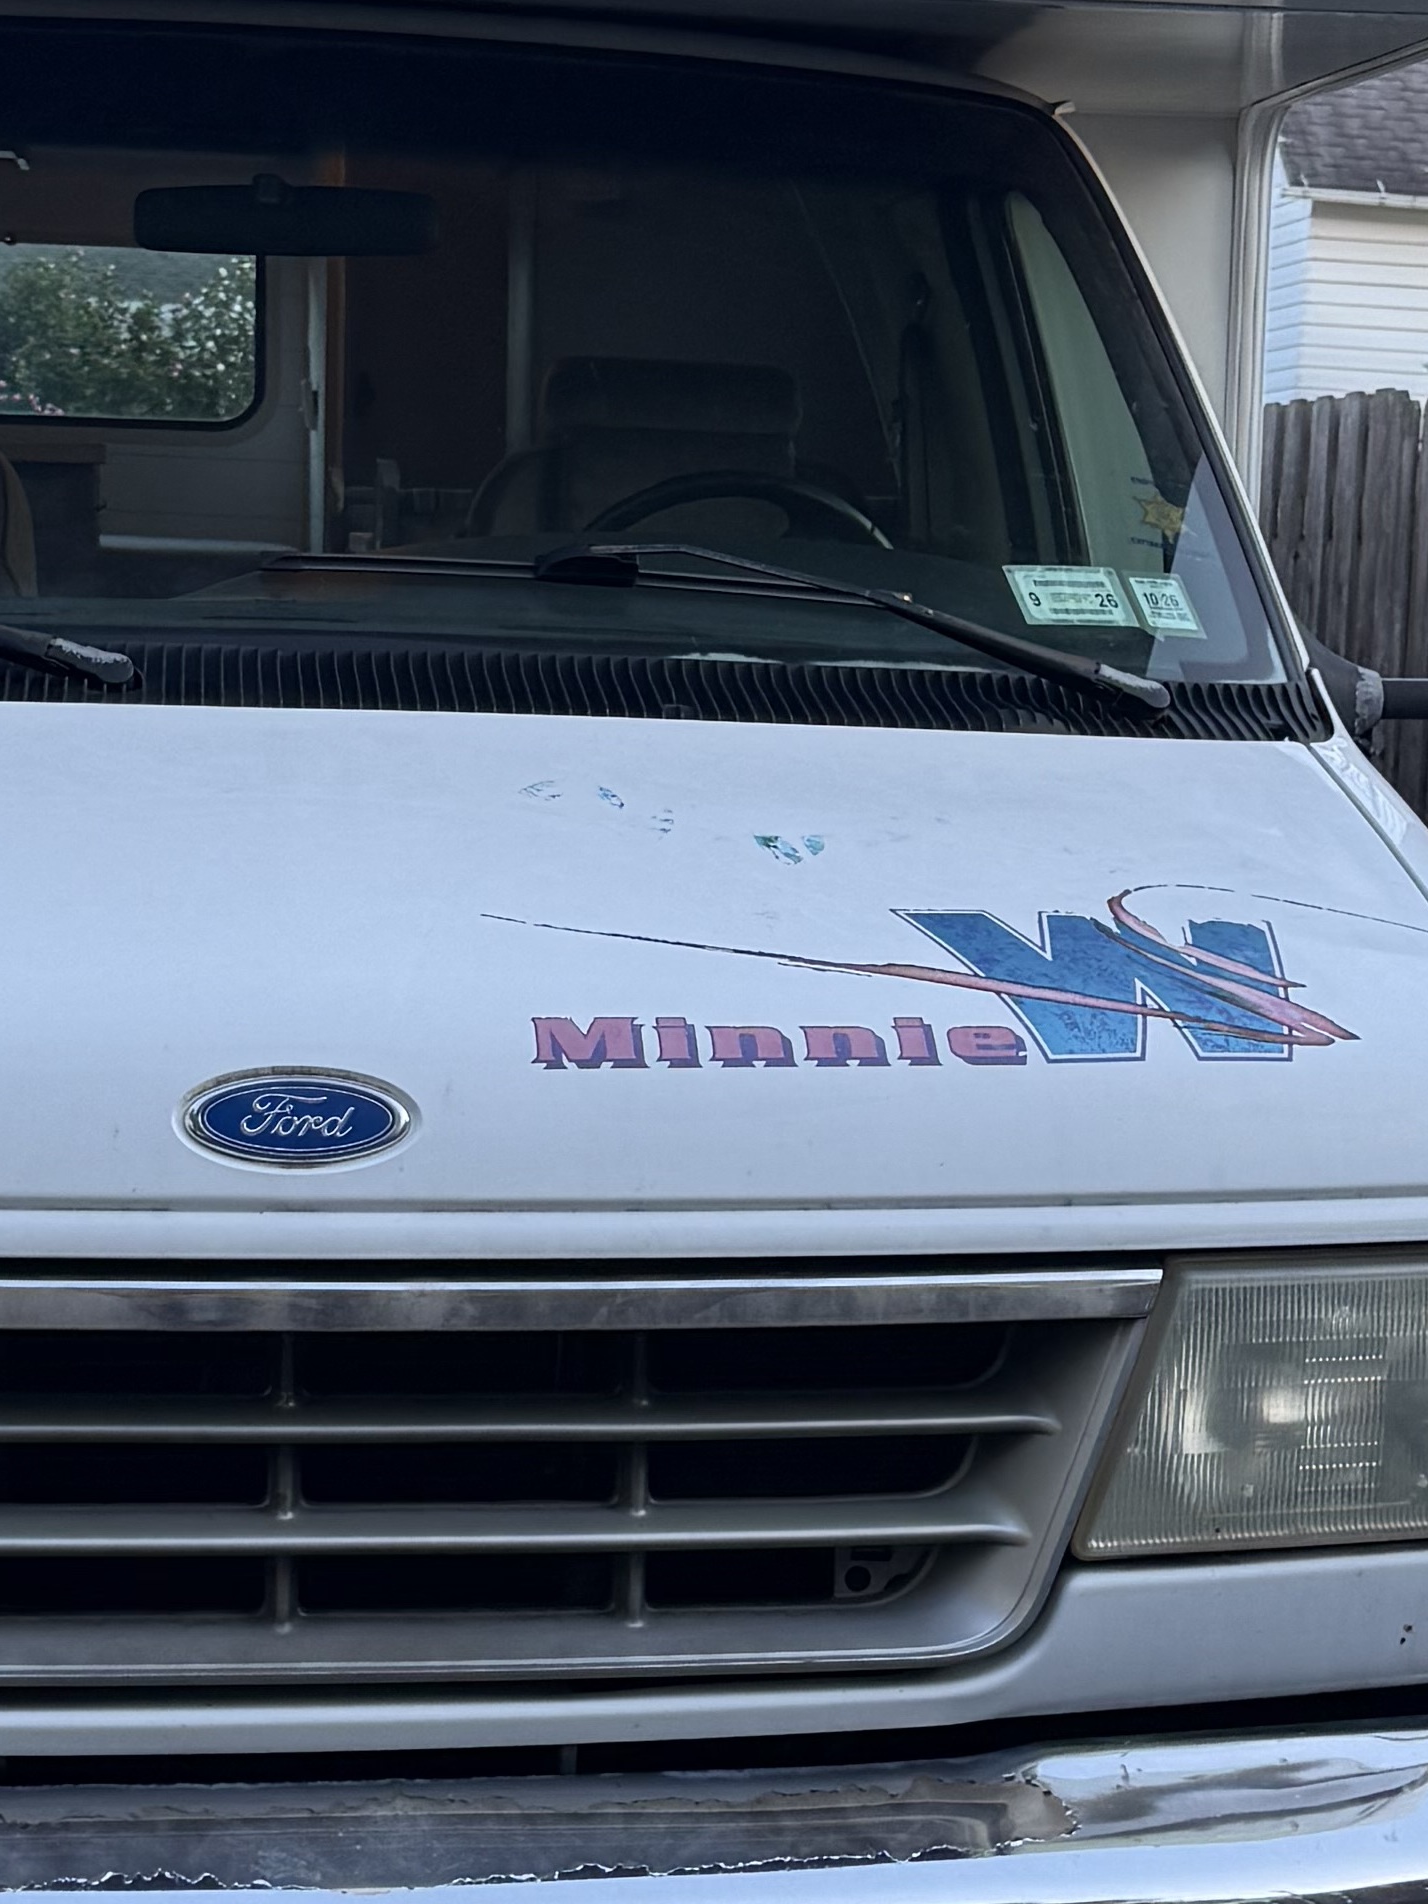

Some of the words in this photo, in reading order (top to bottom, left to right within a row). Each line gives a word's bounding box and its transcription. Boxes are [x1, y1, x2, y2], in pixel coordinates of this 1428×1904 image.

[1028, 592, 1042, 607] 9
[1095, 593, 1119, 608] 26
[531, 1015, 1029, 1069] Minnie
[240, 1093, 355, 1138] Ford
